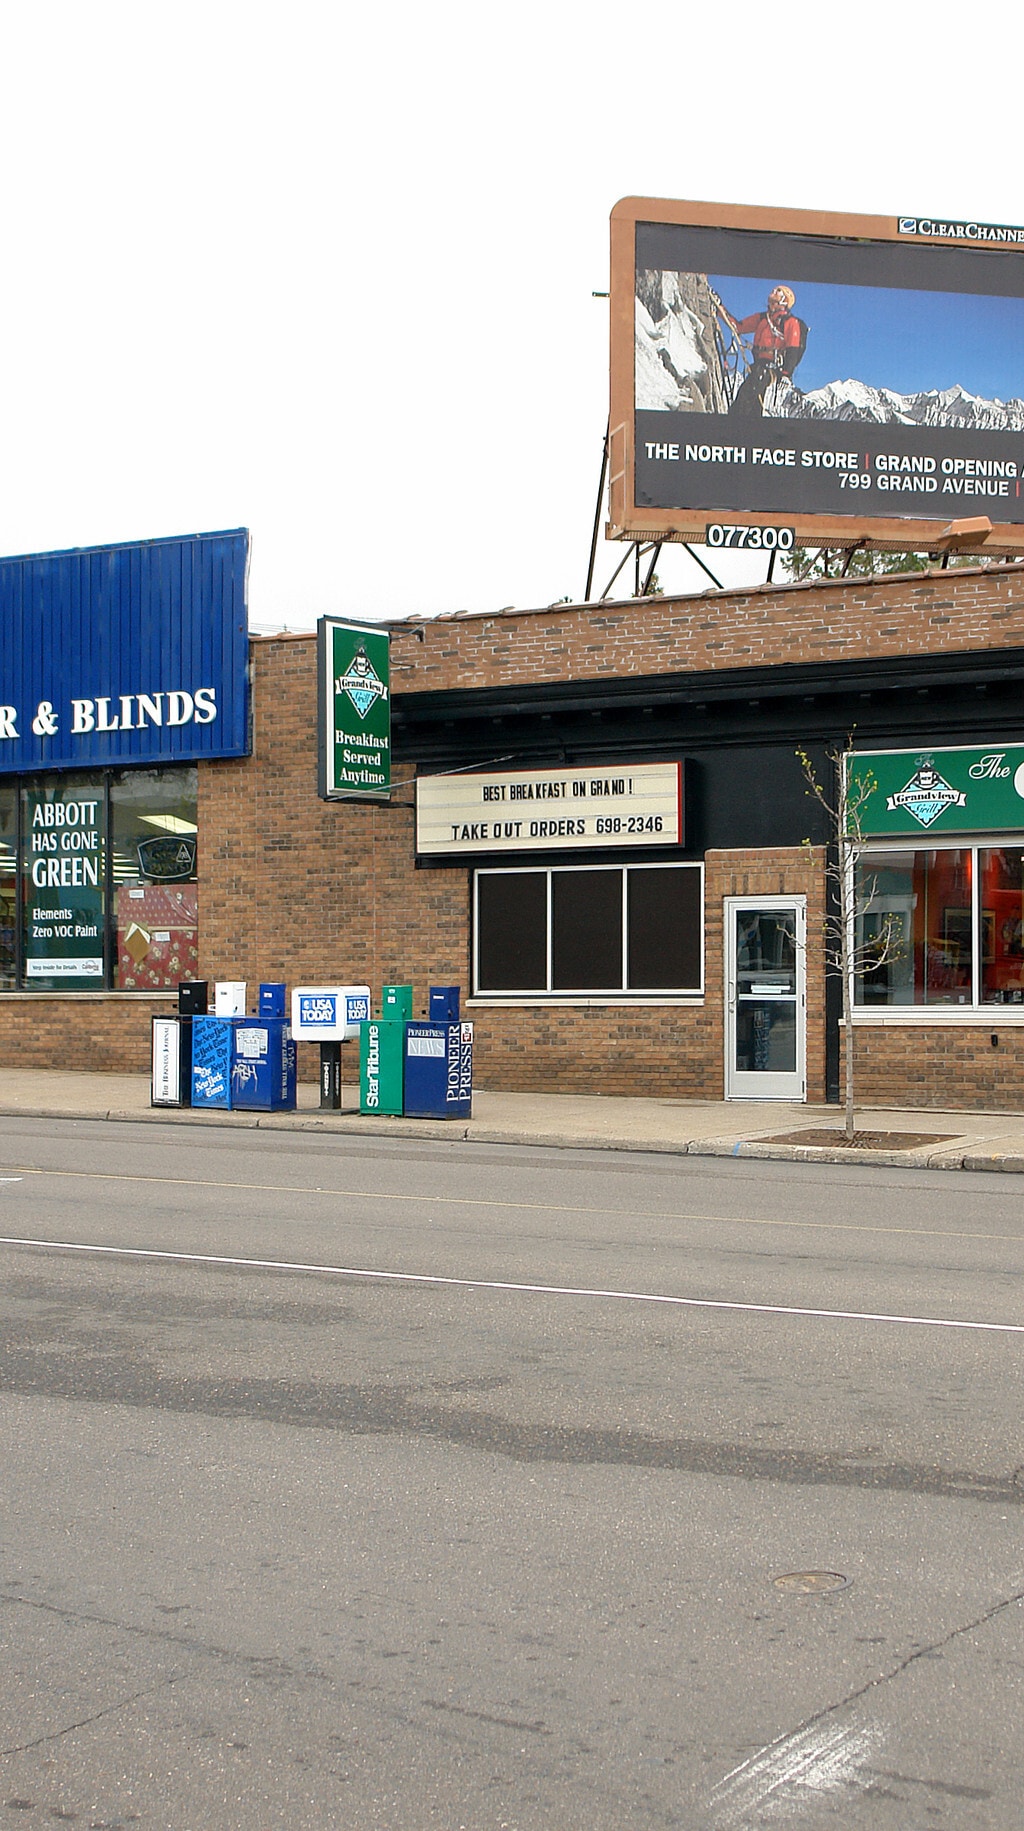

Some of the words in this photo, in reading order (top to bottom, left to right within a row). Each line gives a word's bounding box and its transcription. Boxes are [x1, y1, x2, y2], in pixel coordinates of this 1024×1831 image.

[645, 442, 680, 462] THE
[685, 445, 747, 466] NORTH
[751, 447, 797, 467] FACE
[801, 449, 859, 471] STORE
[875, 454, 937, 475] GRAND
[941, 456, 1017, 479] OPENING
[838, 471, 872, 491] 799
[876, 473, 939, 494] GRAND
[942, 476, 1009, 498] AVENUE
[708, 525, 793, 550] 077300
[32, 701, 59, 736] &
[71, 687, 217, 734] BLINDS
[335, 729, 389, 750] Breakfast
[343, 749, 382, 766] Served
[968, 753, 1012, 779] The
[339, 767, 386, 786] Anytime
[482, 786, 507, 802] BEST
[510, 781, 567, 801] BREAKFAST
[573, 780, 587, 797] ON
[896, 791, 958, 802] Grandview
[32, 801, 98, 828] ABBOTT
[452, 825, 488, 841] TAKE
[493, 822, 523, 838] OUT
[530, 819, 586, 837] ORDERS
[596, 816, 663, 834] 698-2346
[32, 832, 58, 852] HAS
[61, 831, 98, 850] GONE
[32, 856, 98, 888] GREEN
[32, 908, 73, 921] Elements
[32, 925, 53, 938] Zero
[54, 925, 73, 937] VOC
[75, 925, 98, 937] Paint
[312, 999, 333, 1010] USA
[348, 1009, 368, 1019] TODAY
[354, 1000, 366, 1010] USA
[302, 1009, 334, 1022] TODAY
[446, 1024, 460, 1102] PIONEER
[458, 1044, 472, 1101] PRESS
